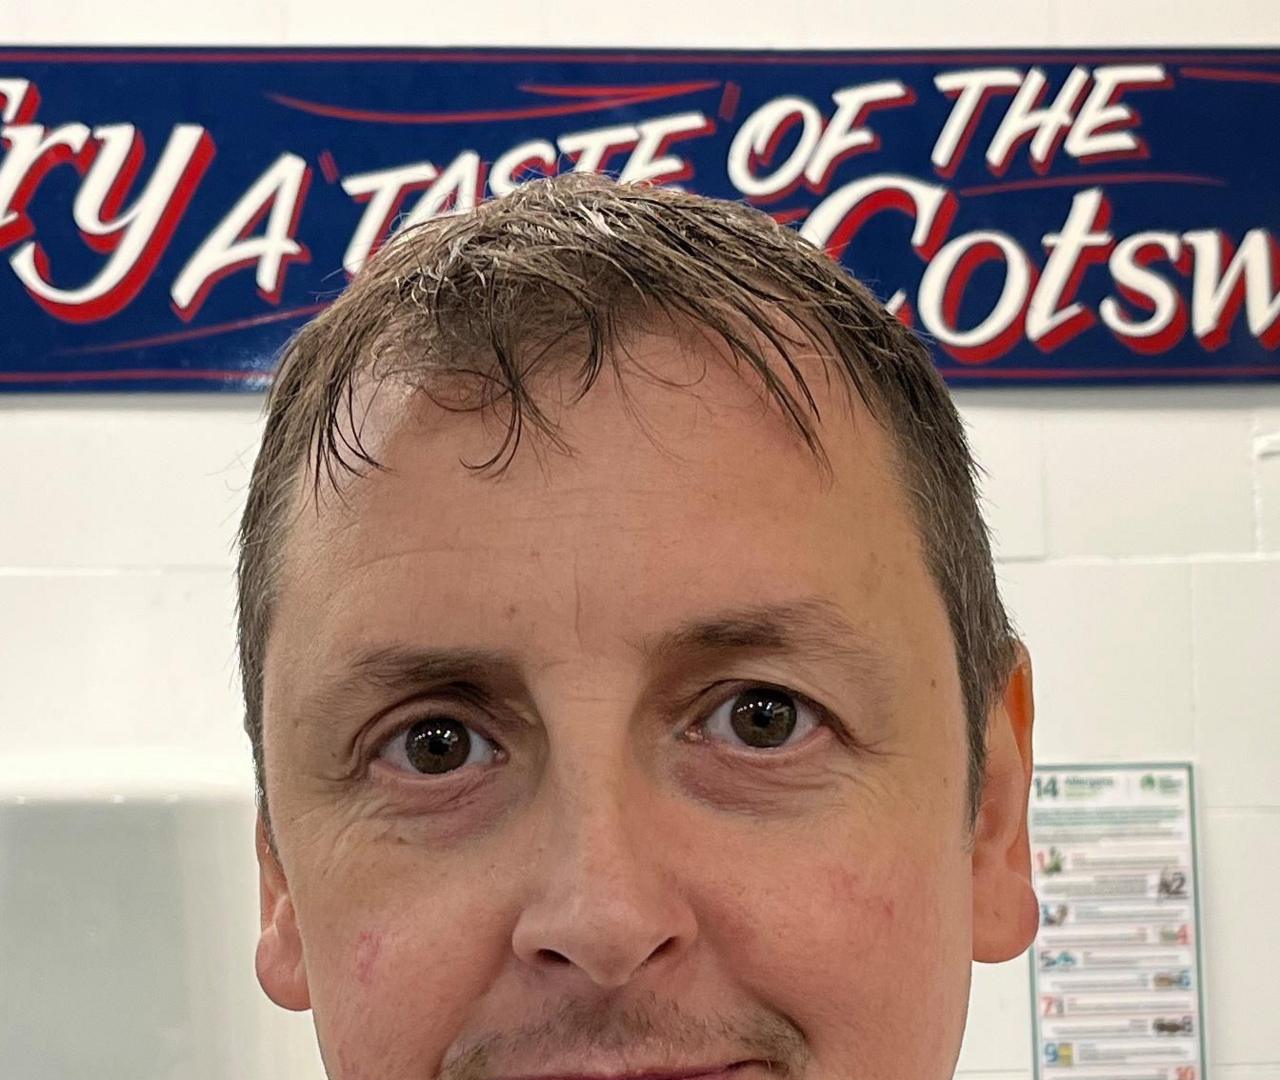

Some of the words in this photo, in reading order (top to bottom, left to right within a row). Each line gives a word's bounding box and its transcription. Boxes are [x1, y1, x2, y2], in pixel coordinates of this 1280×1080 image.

[171, 152, 308, 314] A
[727, 80, 912, 200] OF
[930, 63, 1170, 172] THE
[1033, 776, 1059, 798] 14
